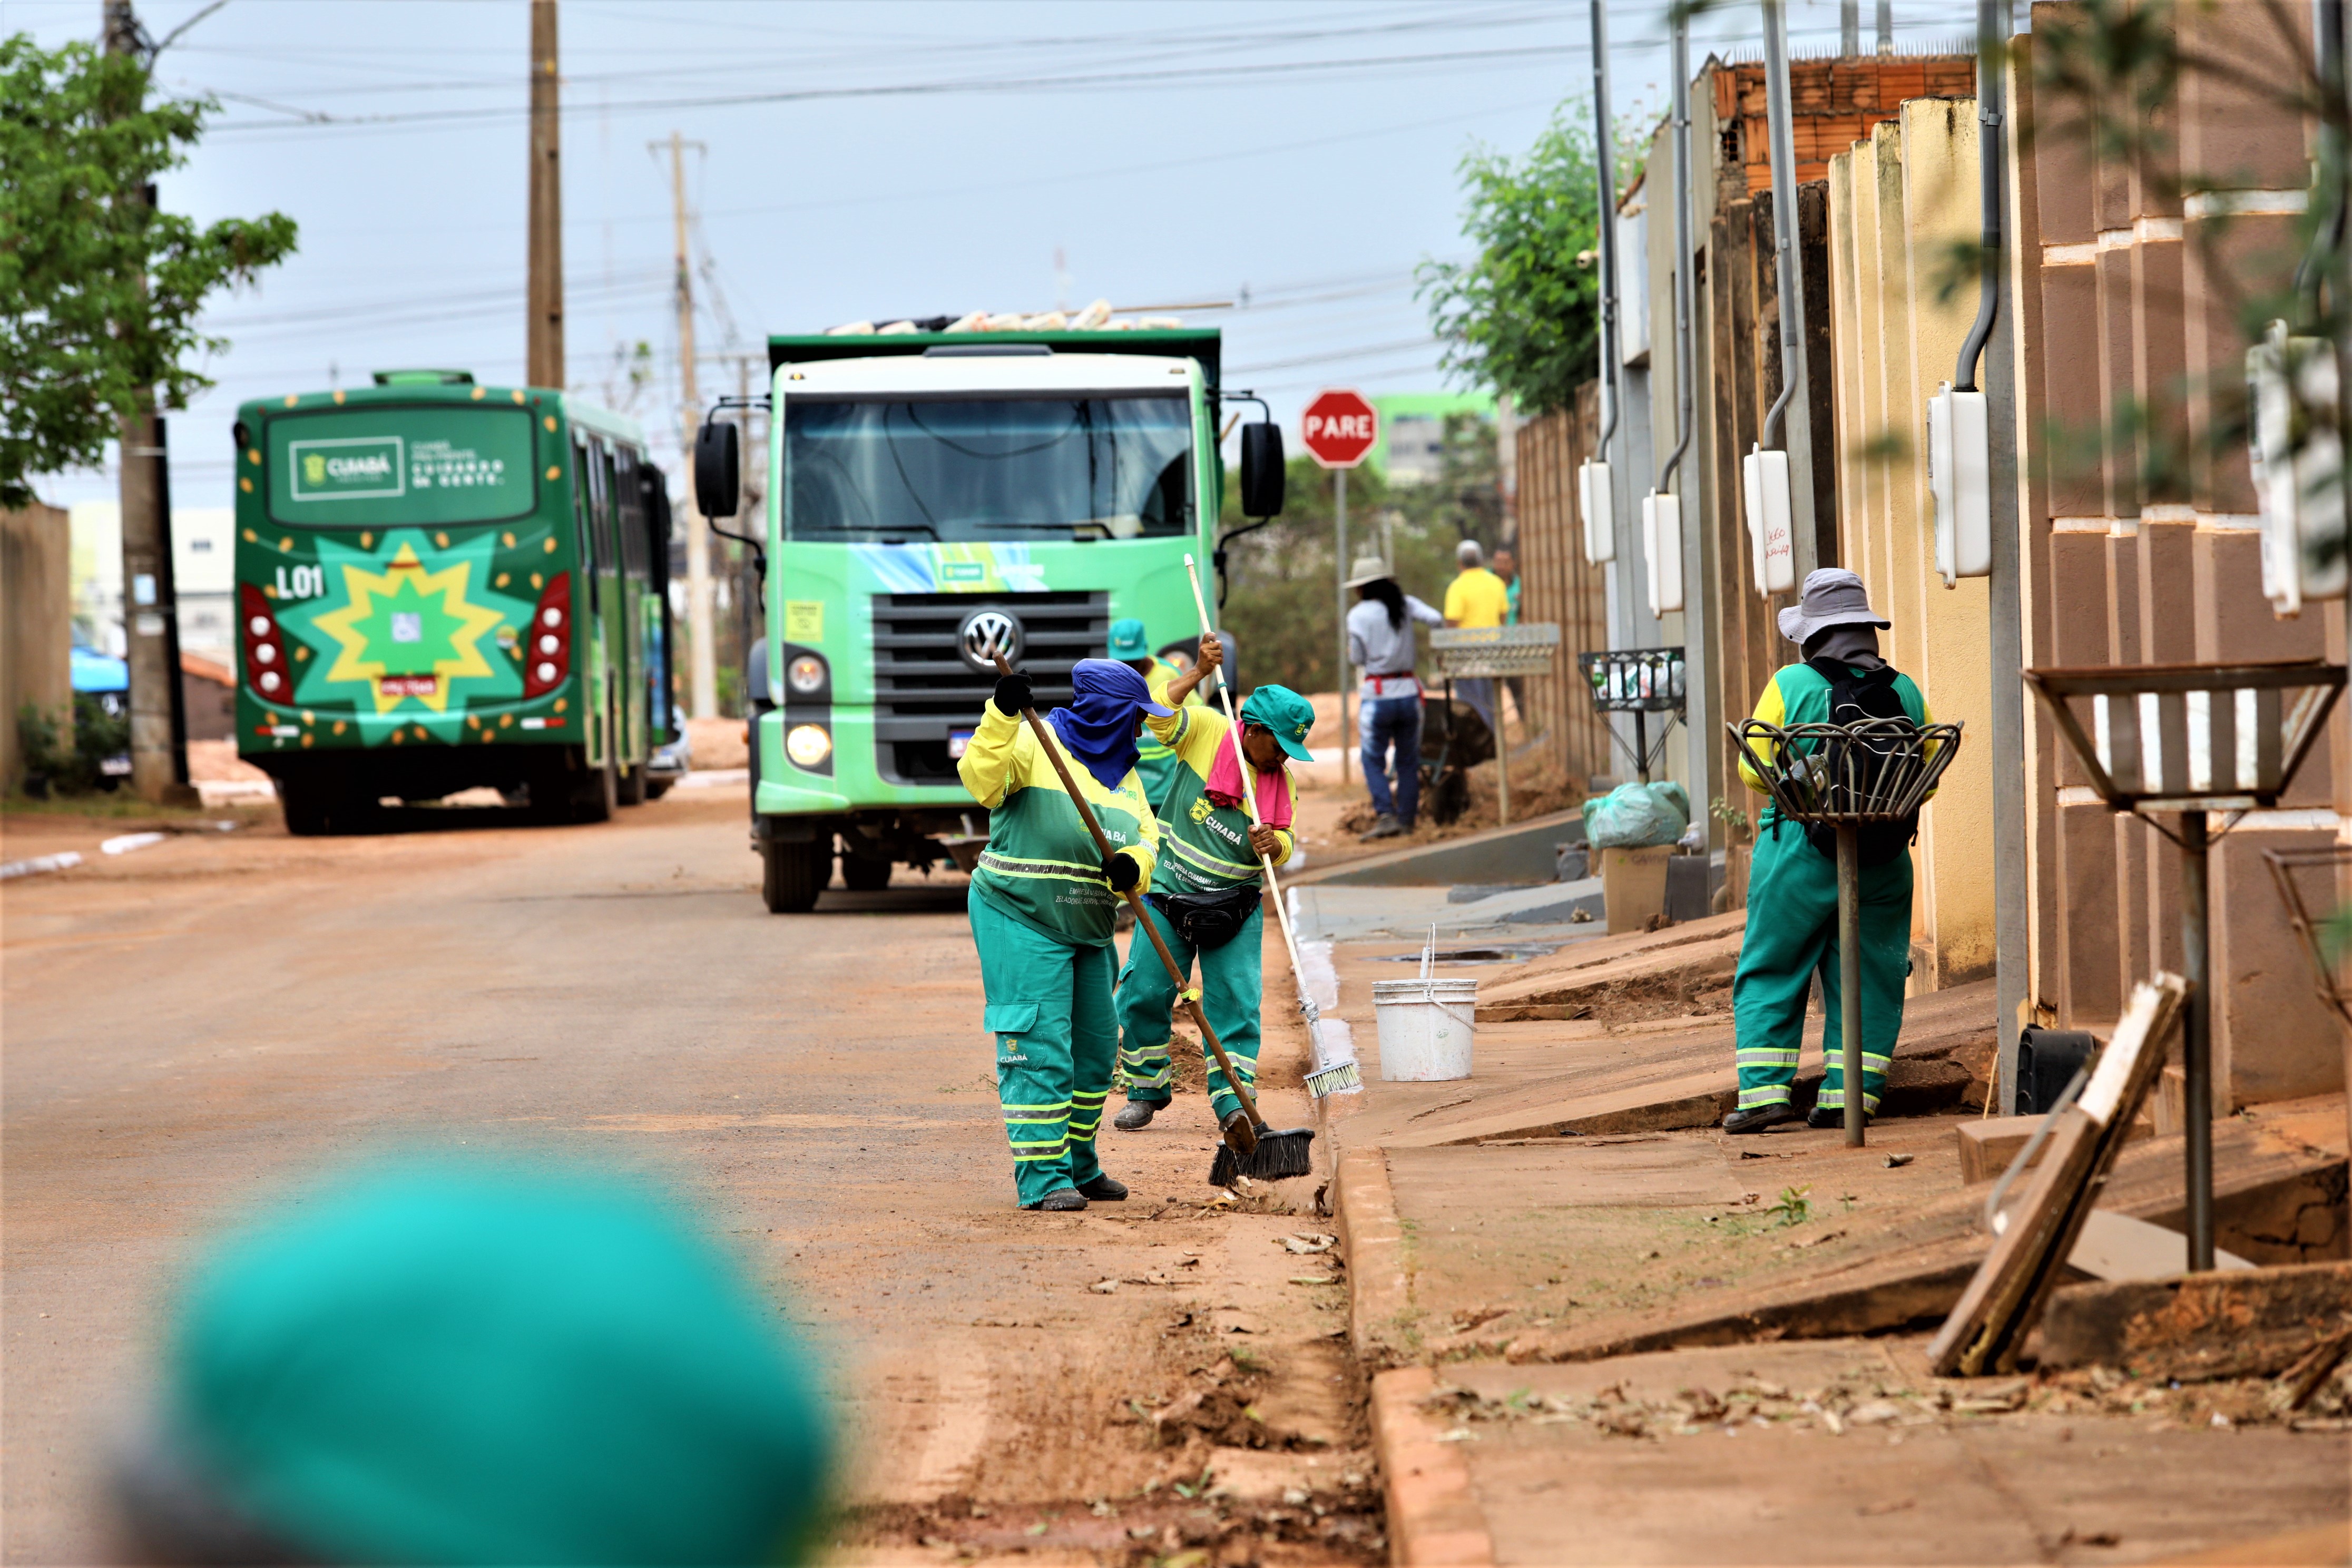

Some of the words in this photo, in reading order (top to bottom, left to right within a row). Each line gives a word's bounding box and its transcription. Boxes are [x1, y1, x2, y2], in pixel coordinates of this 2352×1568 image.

[1306, 415, 1373, 439] PARE
[276, 564, 324, 600] L01
[1206, 816, 1242, 845] CUIABÁ
[1207, 826, 1233, 845] PREFEITURA
[1174, 862, 1188, 876] PRESA
[1188, 871, 1212, 886] CUIABANA
[1000, 1053, 1028, 1063] CUIABÁ
